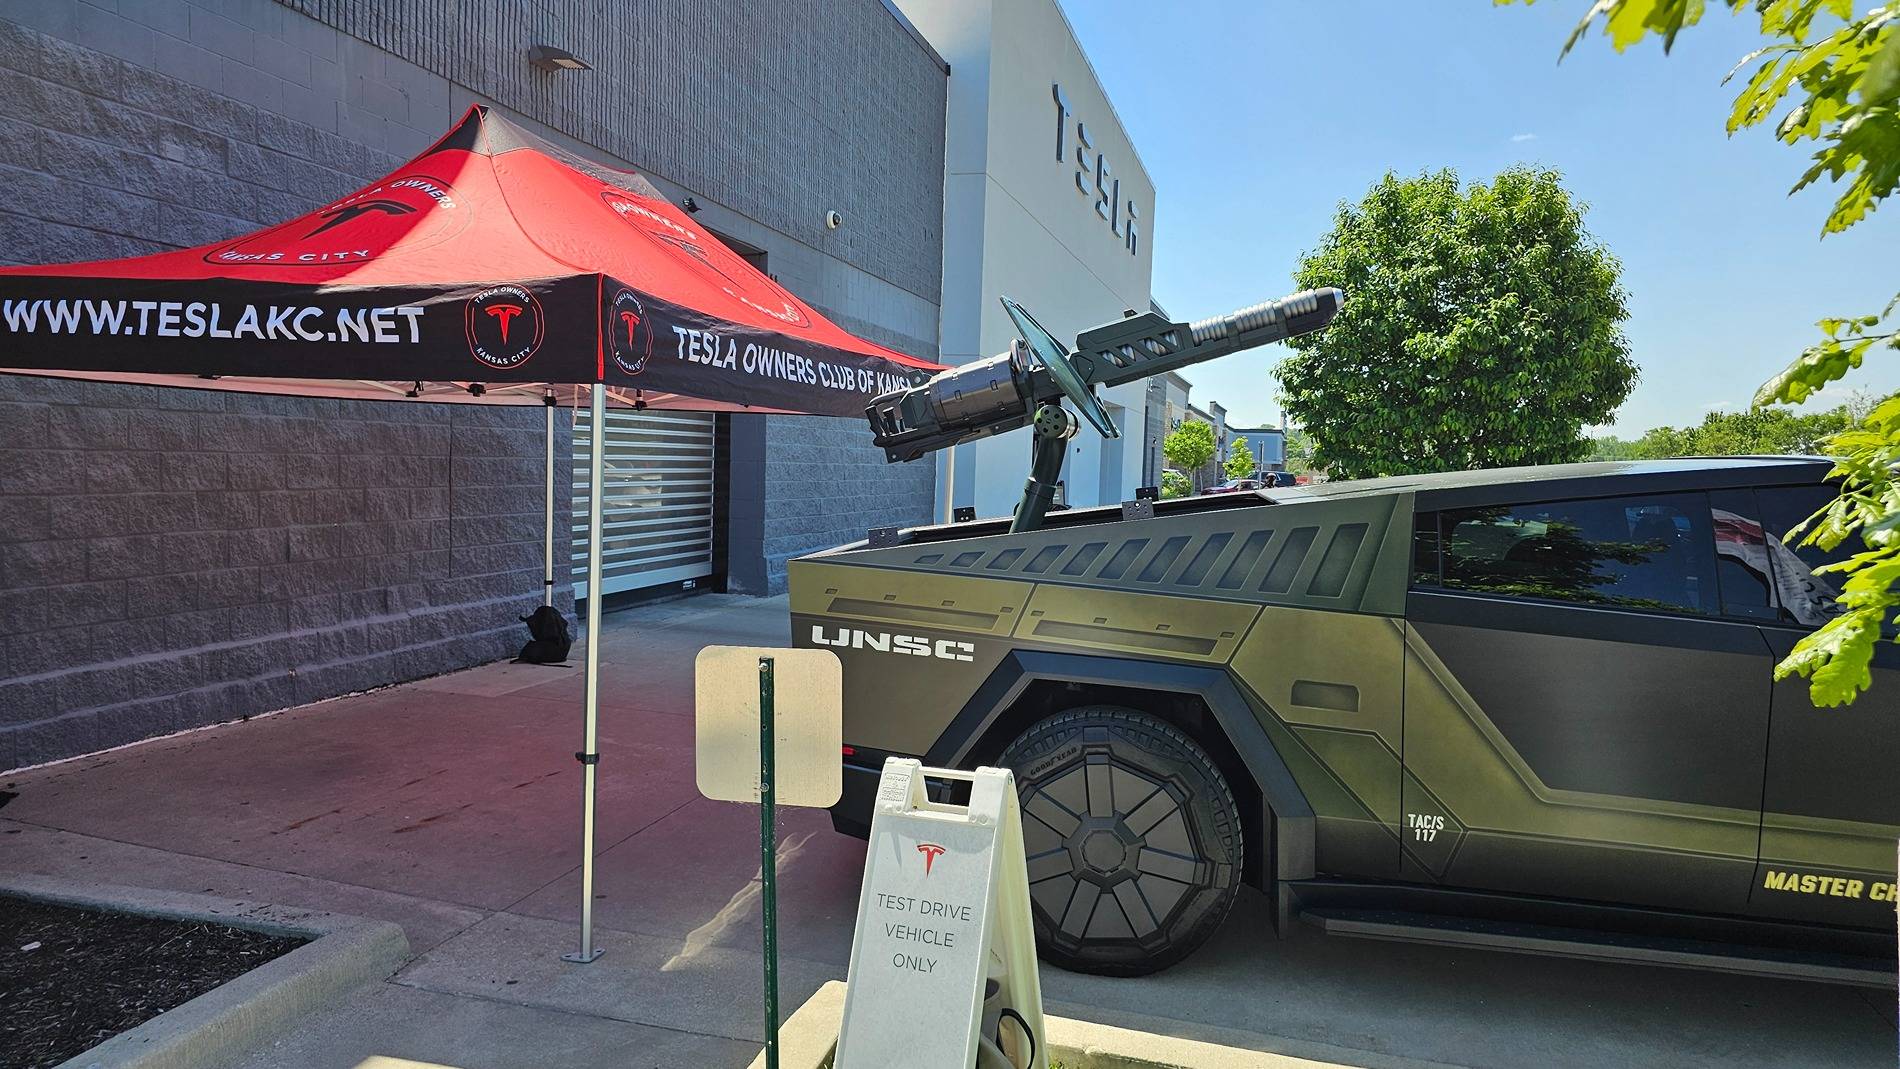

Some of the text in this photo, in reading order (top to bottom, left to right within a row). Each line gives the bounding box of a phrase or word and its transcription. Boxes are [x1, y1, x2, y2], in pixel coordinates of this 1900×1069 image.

[1052, 83, 1140, 256] TESLA
[390, 179, 457, 209] OWNERS
[298, 249, 369, 261] CITY
[474, 286, 530, 304] TESLA OWNERS
[3, 299, 425, 344] WWW.TESLAKC.NET
[476, 346, 531, 365] KANSAS CITY
[671, 325, 737, 371] TESLA
[742, 342, 817, 385] OWNERS
[817, 361, 855, 391] CLUB
[858, 368, 874, 394] OF
[811, 625, 975, 662] UNSC
[1407, 813, 1445, 830] TAC/S
[1414, 828, 1437, 842] 117
[1763, 870, 1864, 899] MASTER
[877, 893, 972, 922] TEST DRIVE
[885, 922, 955, 948] VEHICLE
[893, 953, 938, 974] ONLY
